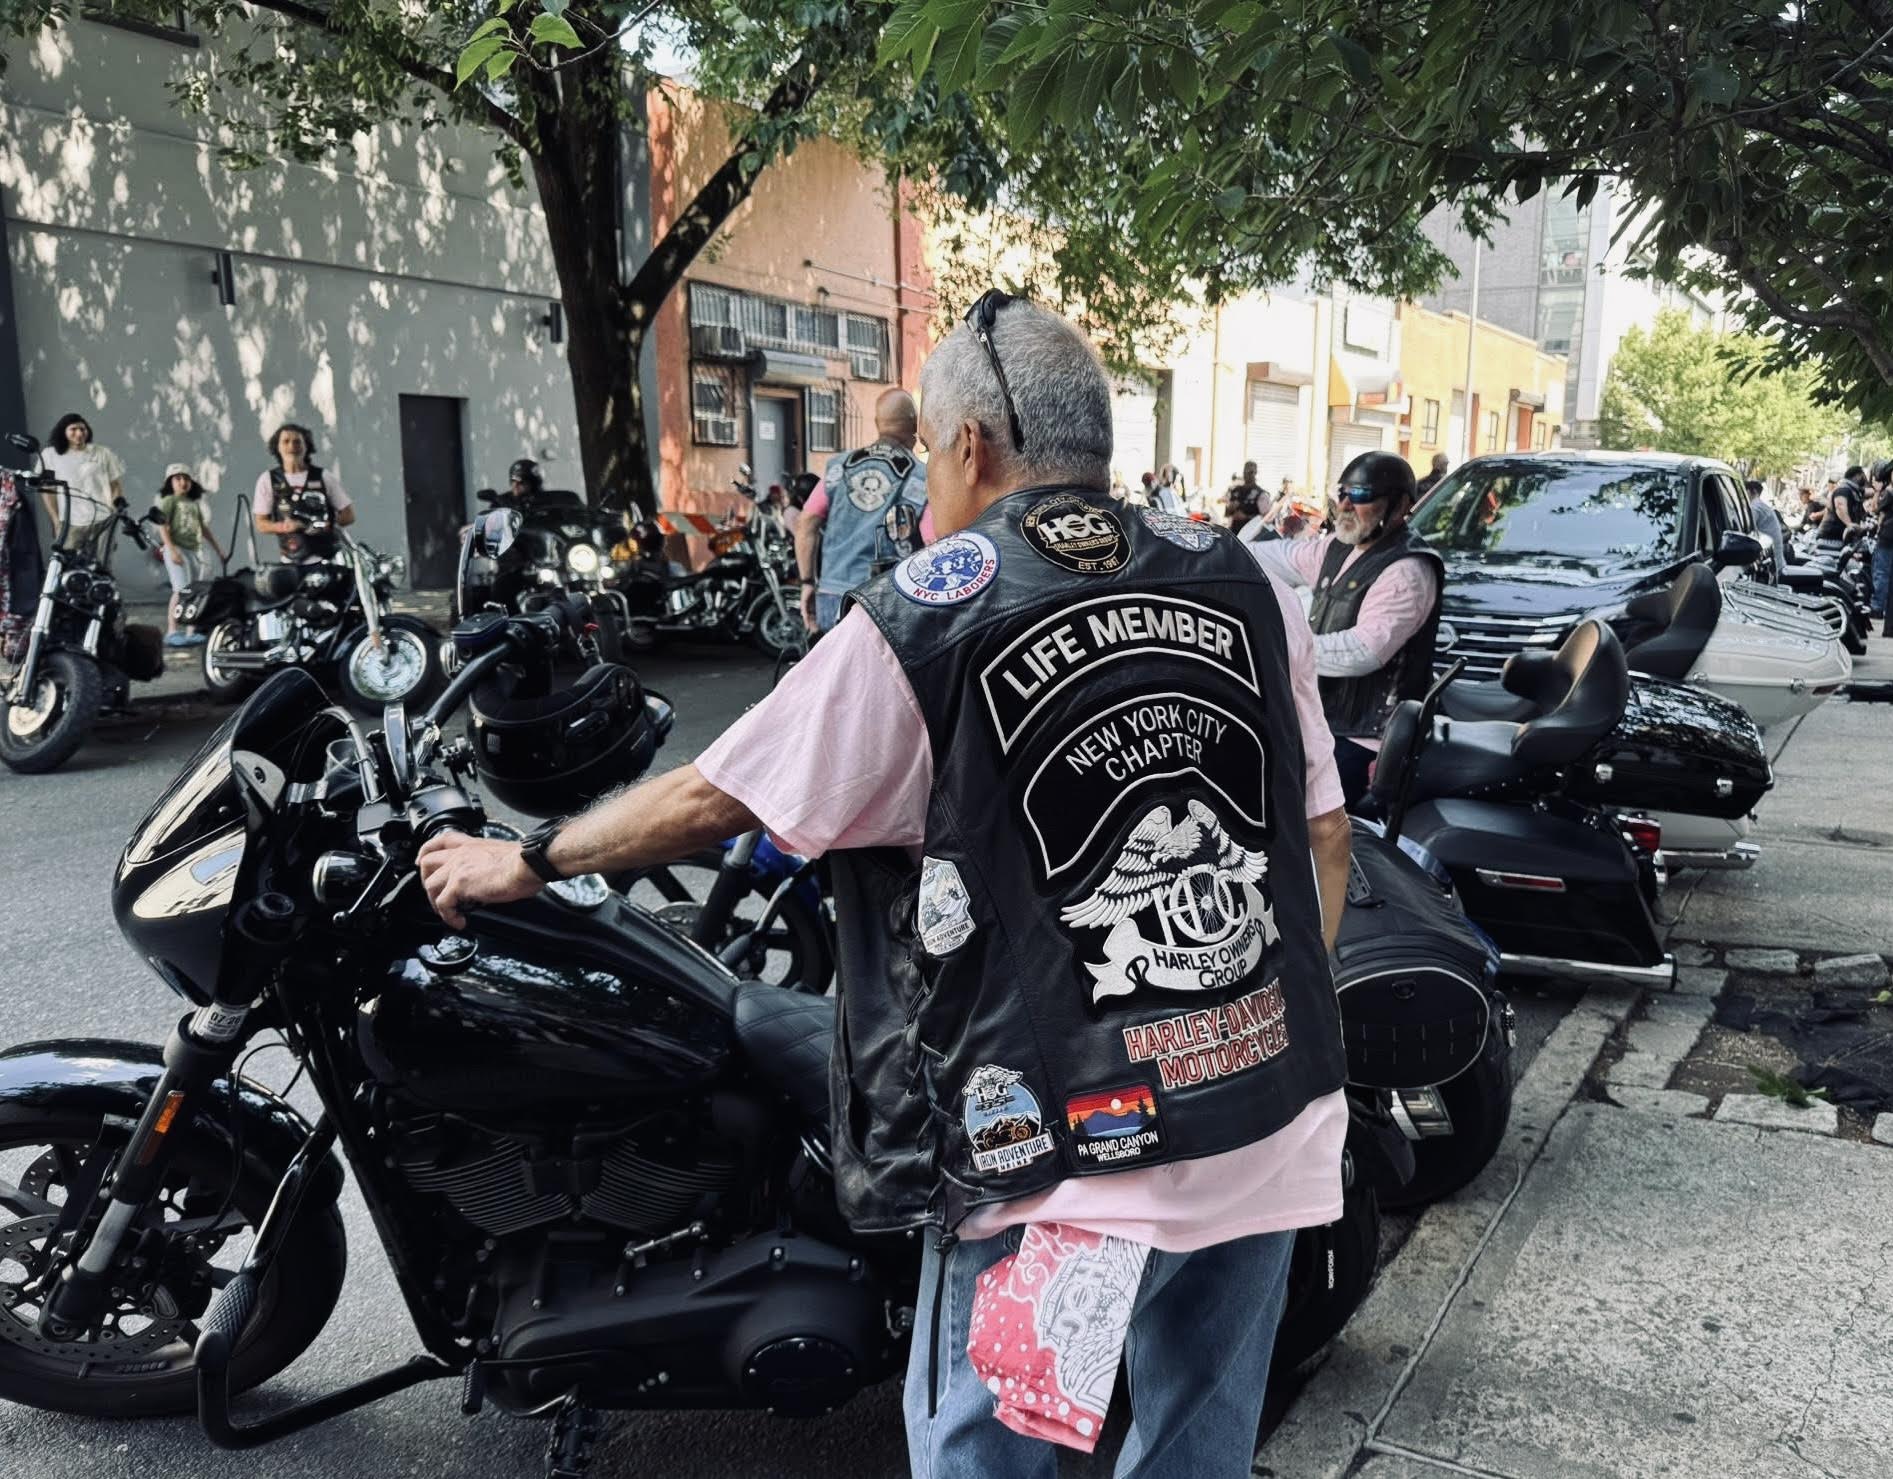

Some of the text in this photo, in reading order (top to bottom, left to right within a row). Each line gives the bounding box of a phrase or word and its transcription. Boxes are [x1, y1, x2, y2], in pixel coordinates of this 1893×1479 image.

[1039, 514, 1112, 544] HOG
[913, 559, 995, 600] NYC LABORERS
[1002, 606, 1233, 700] LIFE MEMBER
[1066, 704, 1227, 775] NEW YORK CITY
[1105, 733, 1202, 781] CHAPTER
[937, 922, 970, 942] ADVENTURE
[1152, 919, 1256, 970] HARLEY OWNERS
[1199, 959, 1248, 988] GROUP
[979, 1137, 1049, 1168] IRON ADVENTURE
[1078, 1130, 1159, 1157] PA GRAND CANYON
[1096, 1147, 1141, 1162] WELLSBORO
